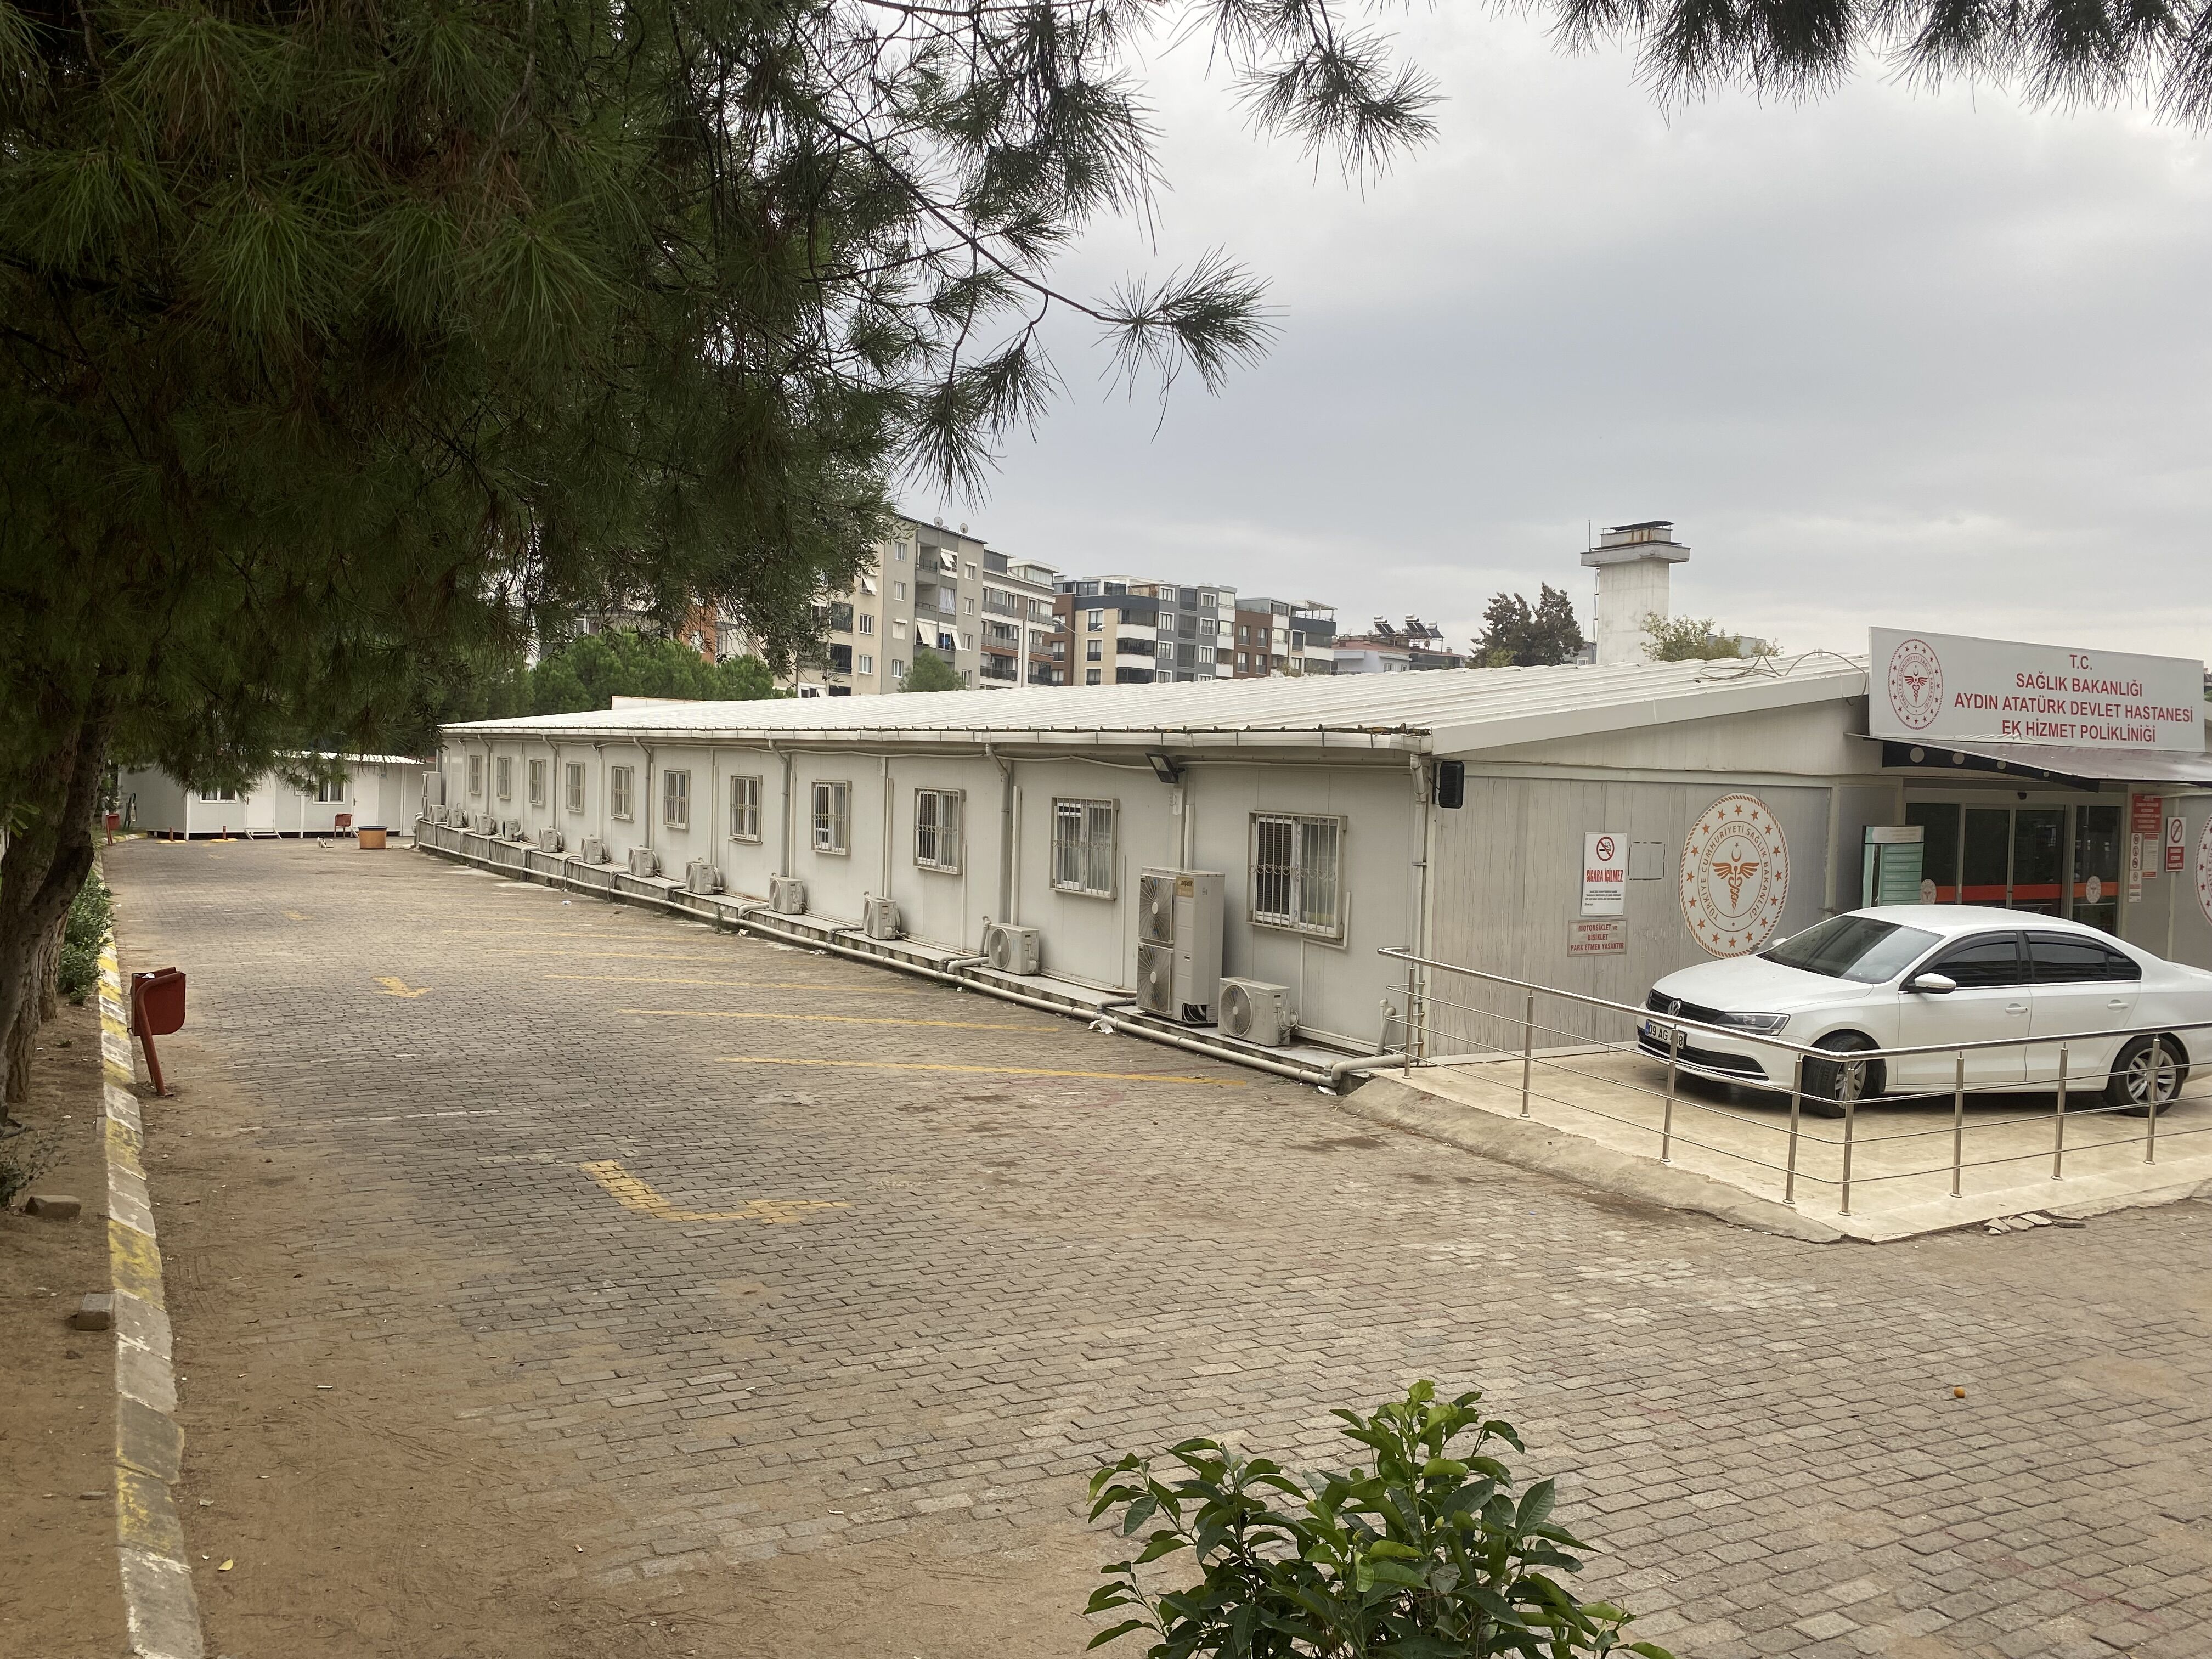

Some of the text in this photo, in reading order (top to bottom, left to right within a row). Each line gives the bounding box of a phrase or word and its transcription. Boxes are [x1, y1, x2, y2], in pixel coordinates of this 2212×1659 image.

[2070, 654, 2092, 670] T.C.
[2016, 671, 2142, 697] SAĞLIK BAKANLIĞI
[1954, 692, 2193, 723] AYDIN ATATÜRK DEVLET HASTANESİ
[2002, 718, 2155, 742] EK HİZMET POLİKLİNİĞİ
[1587, 867, 1623, 884] SİGARA İÇİLMEZ
[1701, 825, 1769, 921] TÜRKİYE CUMHURİYETİ SAĞLIK BAKANLIĞI
[1578, 923, 1611, 932] MOTORSİKLET
[1649, 1024, 1656, 1036] 09
[1658, 1028, 1668, 1040] AG
